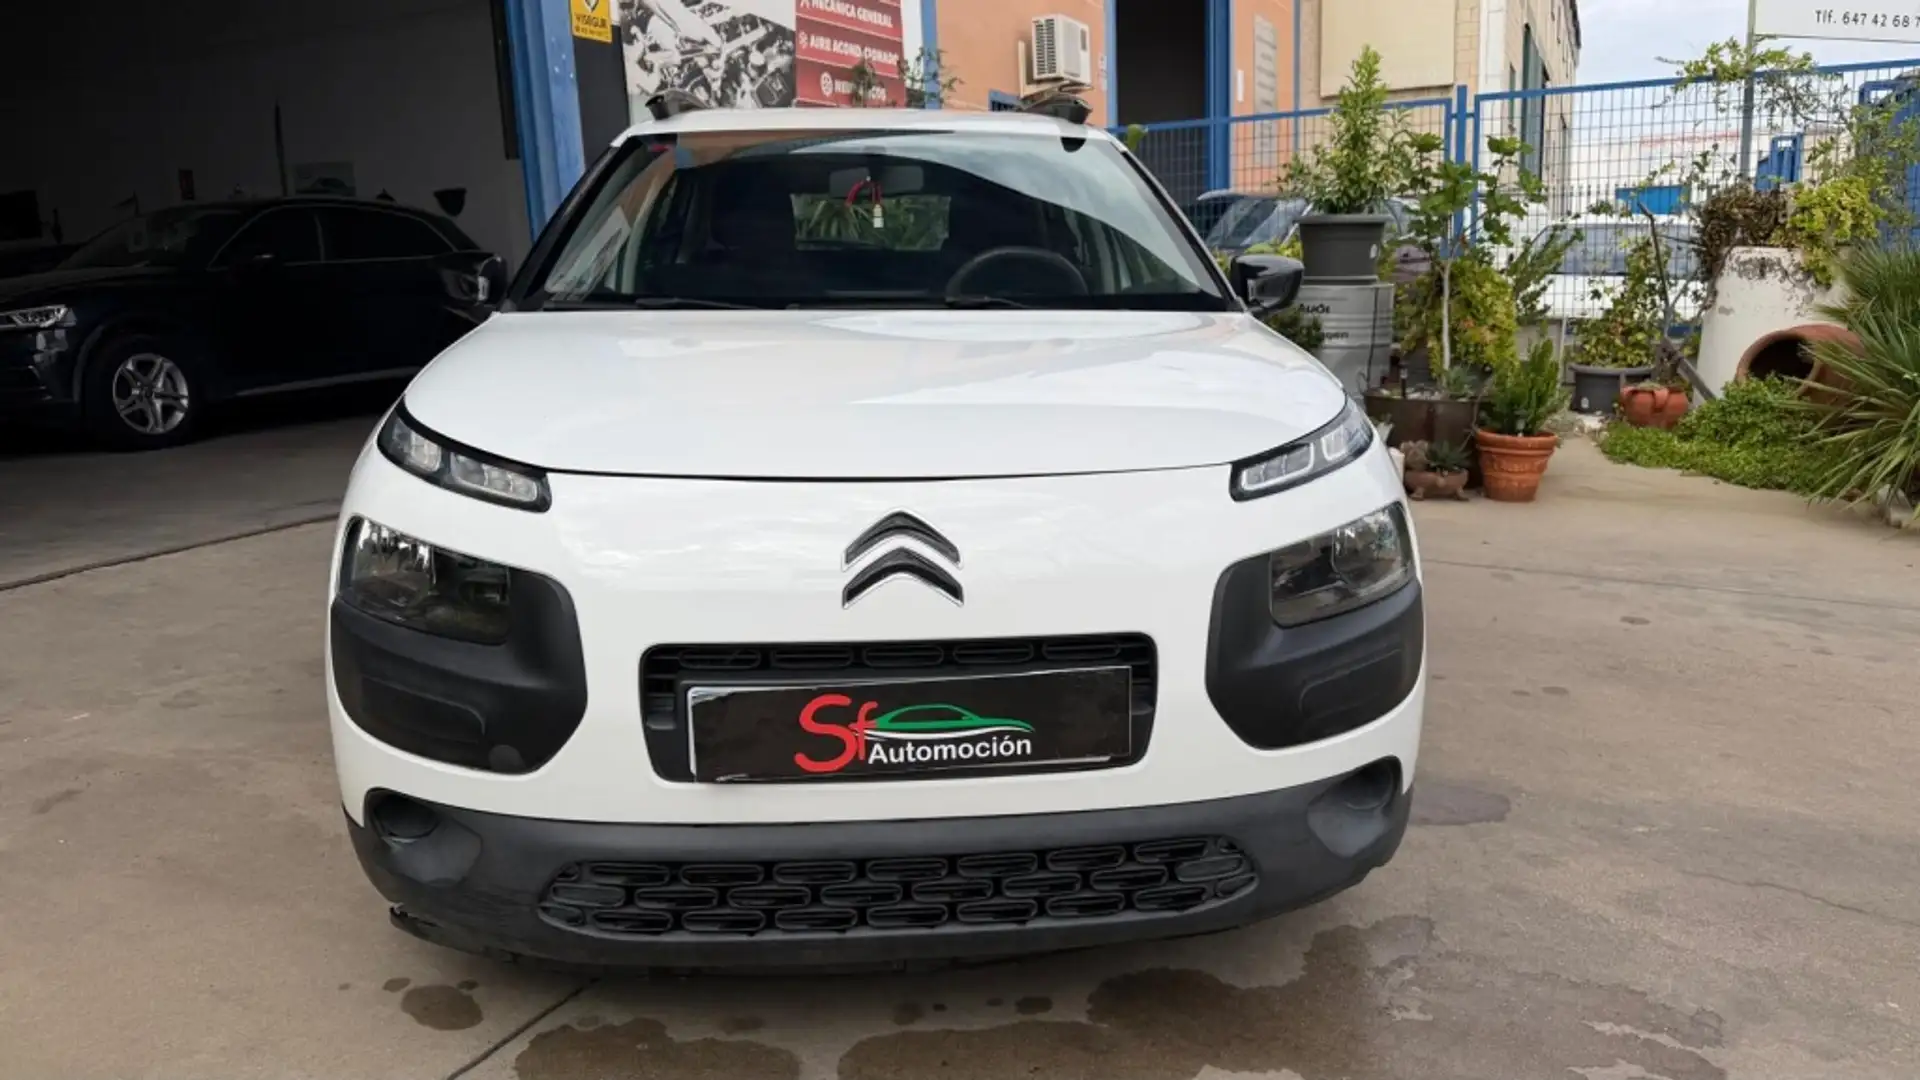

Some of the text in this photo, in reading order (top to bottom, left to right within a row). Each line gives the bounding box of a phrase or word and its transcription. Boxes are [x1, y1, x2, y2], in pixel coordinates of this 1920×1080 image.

[857, 7, 893, 28] GENERAL
[1815, 10, 1837, 24] Tlf.
[1842, 11, 1867, 26] 647
[1871, 13, 1887, 27] 42
[1892, 15, 1910, 28] 68
[810, 34, 831, 52] AIRE
[868, 735, 1032, 766] Automoción
